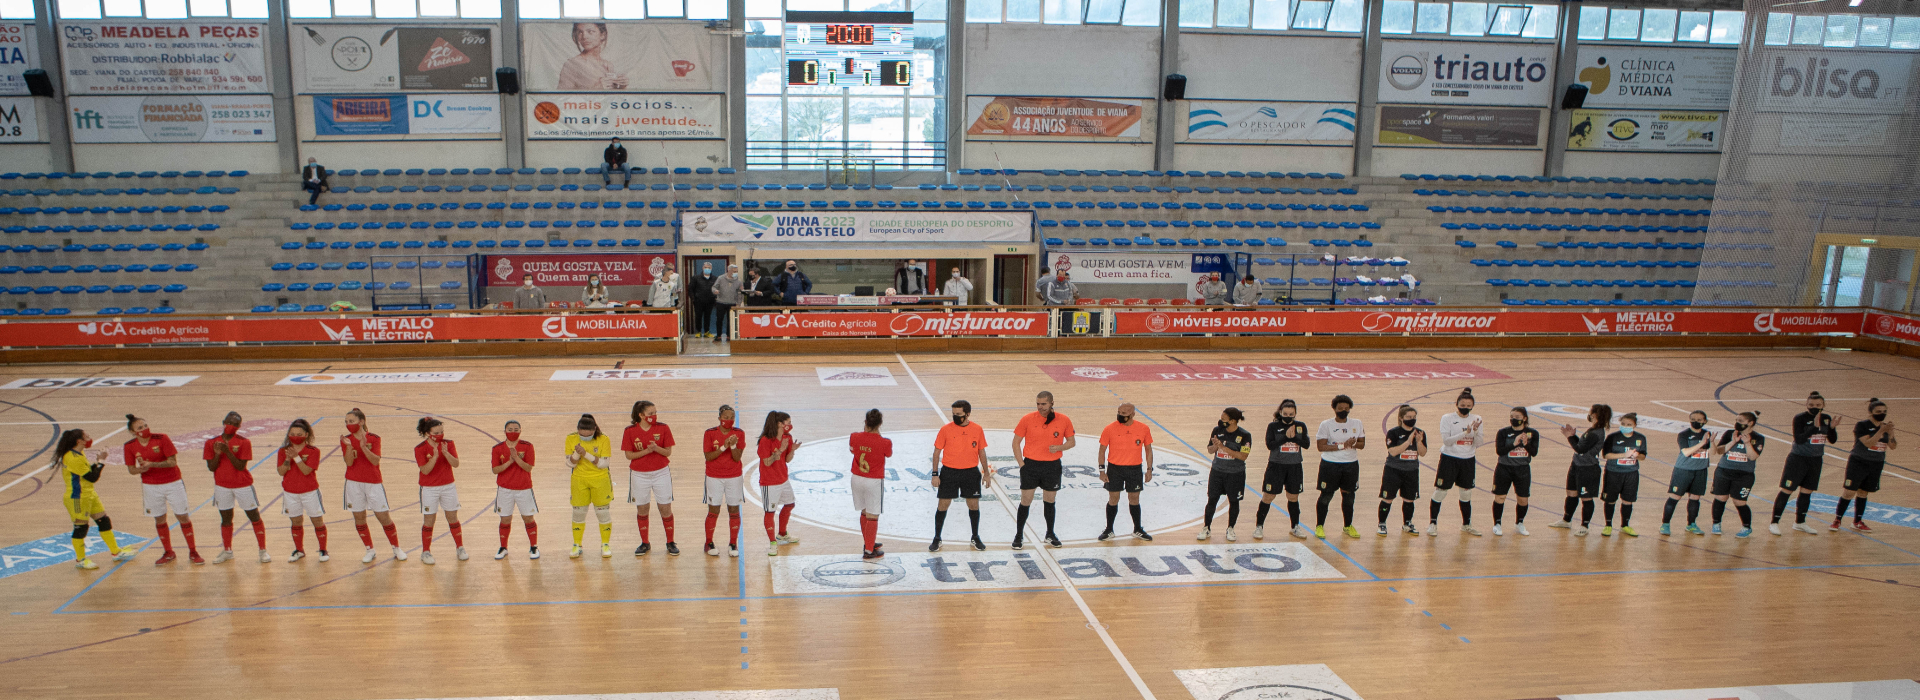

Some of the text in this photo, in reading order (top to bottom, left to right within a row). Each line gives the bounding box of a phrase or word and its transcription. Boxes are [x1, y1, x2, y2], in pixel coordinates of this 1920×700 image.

[0, 35, 22, 43] ÃO
[101, 26, 260, 41] MEADELA PEÇAS
[826, 25, 874, 43] 20:00
[461, 37, 486, 45] 1970
[0, 47, 25, 64] IA
[161, 53, 220, 63] Robbialac
[1434, 54, 1547, 83] triauto
[1621, 58, 1675, 71] CLÍNICA
[1392, 67, 1422, 75] VOLVO
[1619, 72, 1674, 84] MÉDICA
[1631, 86, 1672, 96] VIANA
[143, 103, 203, 114] FORMAÇÃO
[563, 99, 692, 110] mais sócios...
[211, 110, 231, 118] 258
[254, 110, 271, 118] 347
[1013, 106, 1128, 117] ASSOCIAÇÃO JUVENTUDE DE VIANA
[74, 107, 104, 129] ift
[144, 113, 204, 122] FINANCIADA
[564, 115, 712, 127] mais juventude...
[1012, 117, 1067, 133] 44 ANOS
[1240, 121, 1306, 129] O PESCADOR
[777, 216, 856, 226] VIANA 2023
[869, 220, 1014, 228] CIDADE EUROPEIA DO DESPORTO
[777, 227, 856, 236] DO CASTELO
[522, 261, 637, 272] QUEM GOSTA VEM.
[1081, 259, 1187, 269] QUEM GOSTA VEM.
[537, 273, 570, 282] Quem
[1093, 270, 1123, 278] Quem
[1150, 270, 1173, 278] fica.
[774, 315, 877, 329] CA Crédito Agrícola
[1173, 316, 1287, 327] MÓVEIS JOGAPAU
[1393, 312, 1496, 331] misturacor
[1616, 312, 1675, 322] METALO
[1781, 315, 1838, 326] IMOBILIÁRIA
[362, 318, 434, 330] METALO
[576, 317, 648, 329] IMOBILIÁRIA
[924, 313, 1035, 334] misturacor
[1615, 322, 1673, 332] ELÉCTRICA
[100, 322, 209, 336] CA Crédito Agrícola
[363, 329, 434, 340] ELÉCTRICA
[859, 453, 870, 473] 6
[920, 549, 1302, 583] triauto
